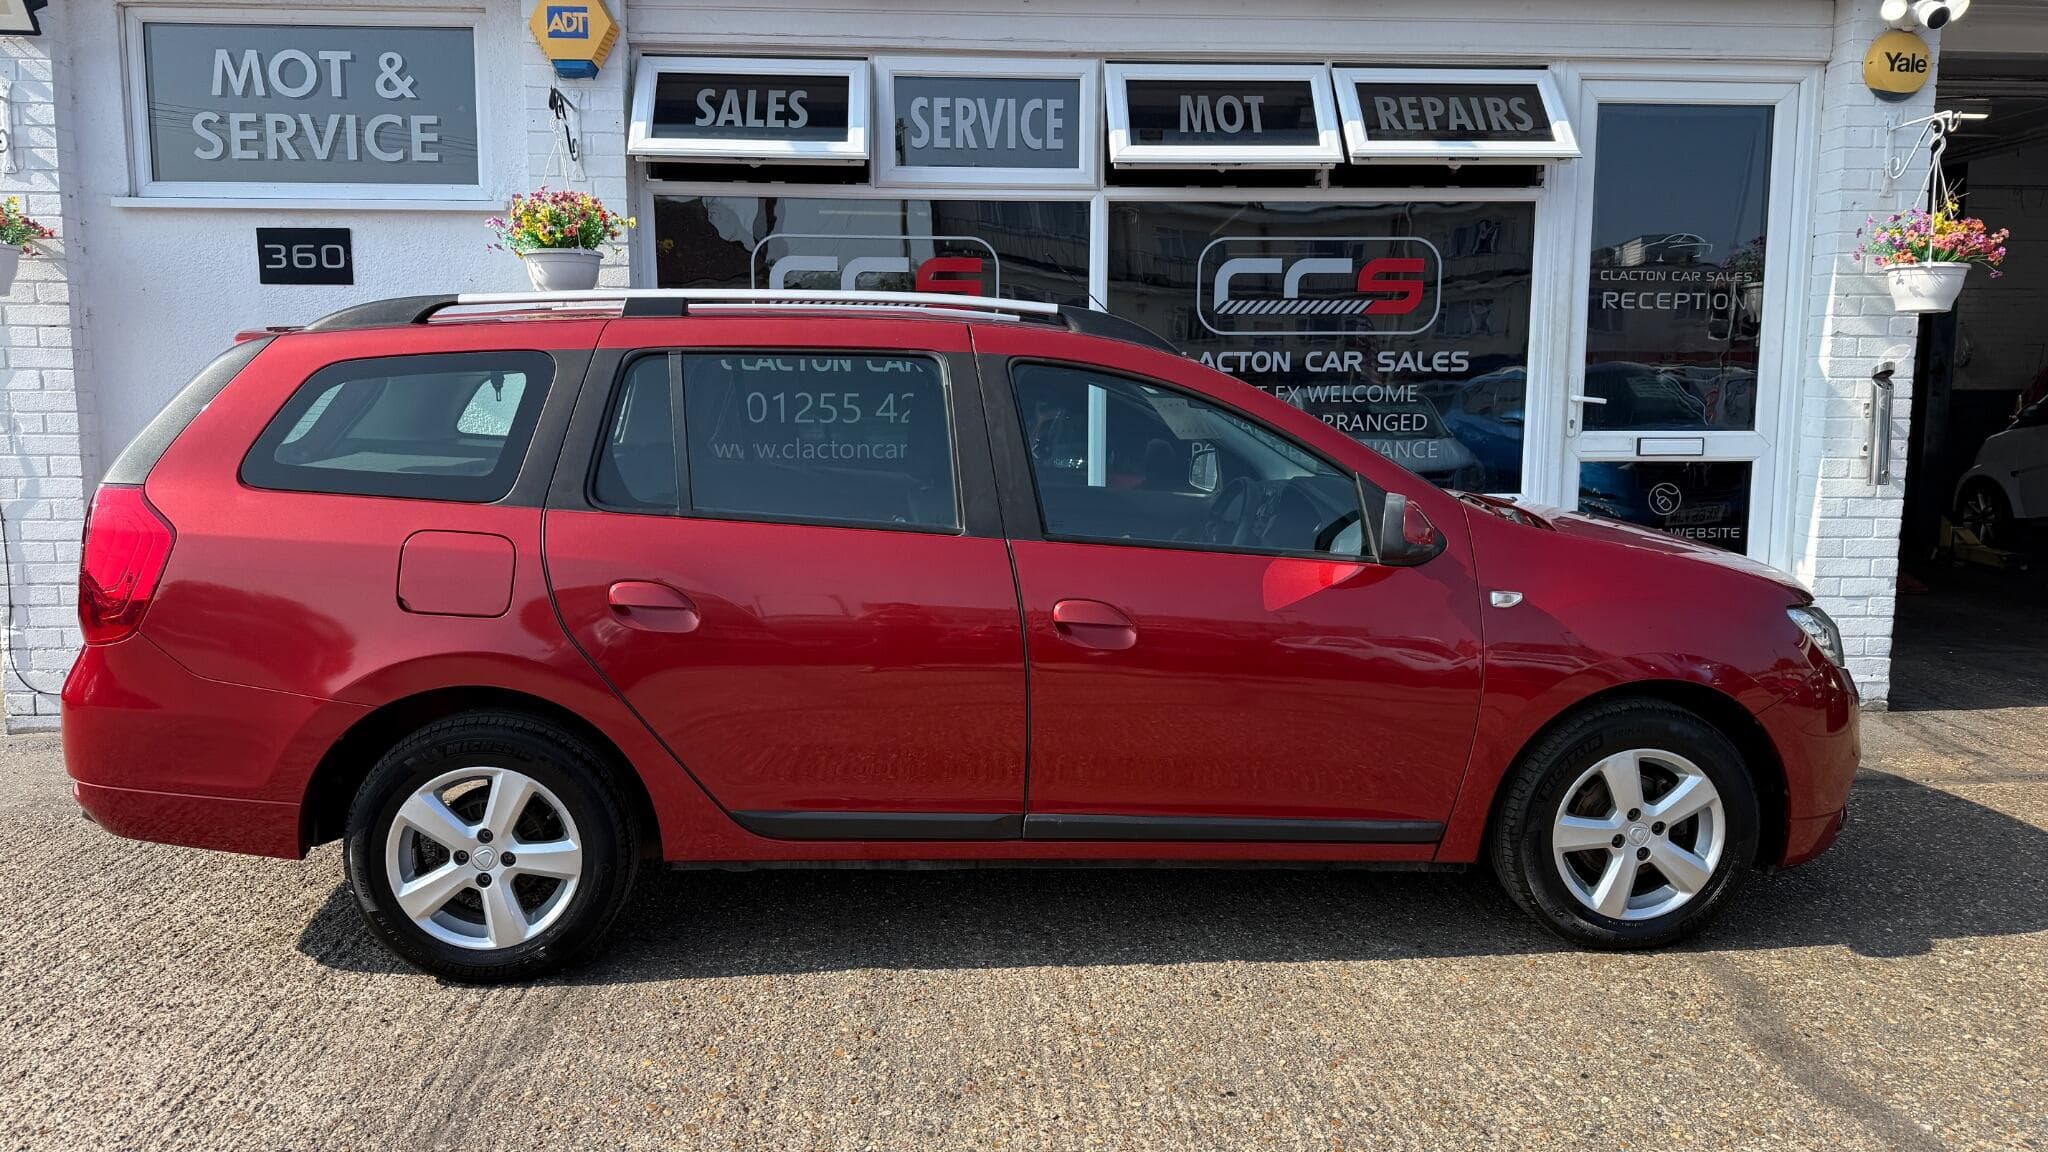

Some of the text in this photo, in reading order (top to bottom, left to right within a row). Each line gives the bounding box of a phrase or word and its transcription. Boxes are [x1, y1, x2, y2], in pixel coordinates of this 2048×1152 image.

[547, 11, 589, 33] ADT
[211, 48, 418, 99] MOT &
[1885, 51, 1928, 74] Yale
[695, 88, 809, 129] SALES
[1179, 94, 1265, 134] MOT
[1373, 95, 1535, 132] REPAIRS
[910, 96, 1065, 150] SERVICE
[191, 111, 440, 162] SERVICE
[264, 243, 346, 270] 360
[1600, 270, 1753, 283] CLACTON CAR SALES
[1601, 291, 1749, 311] RECEPTION
[1182, 351, 1470, 373] ACTON CAR SALES
[1307, 384, 1418, 403] WELCOME
[747, 391, 861, 424] 01255
[1318, 413, 1428, 432] RRANGED
[1669, 527, 1740, 539] WEBSITE
